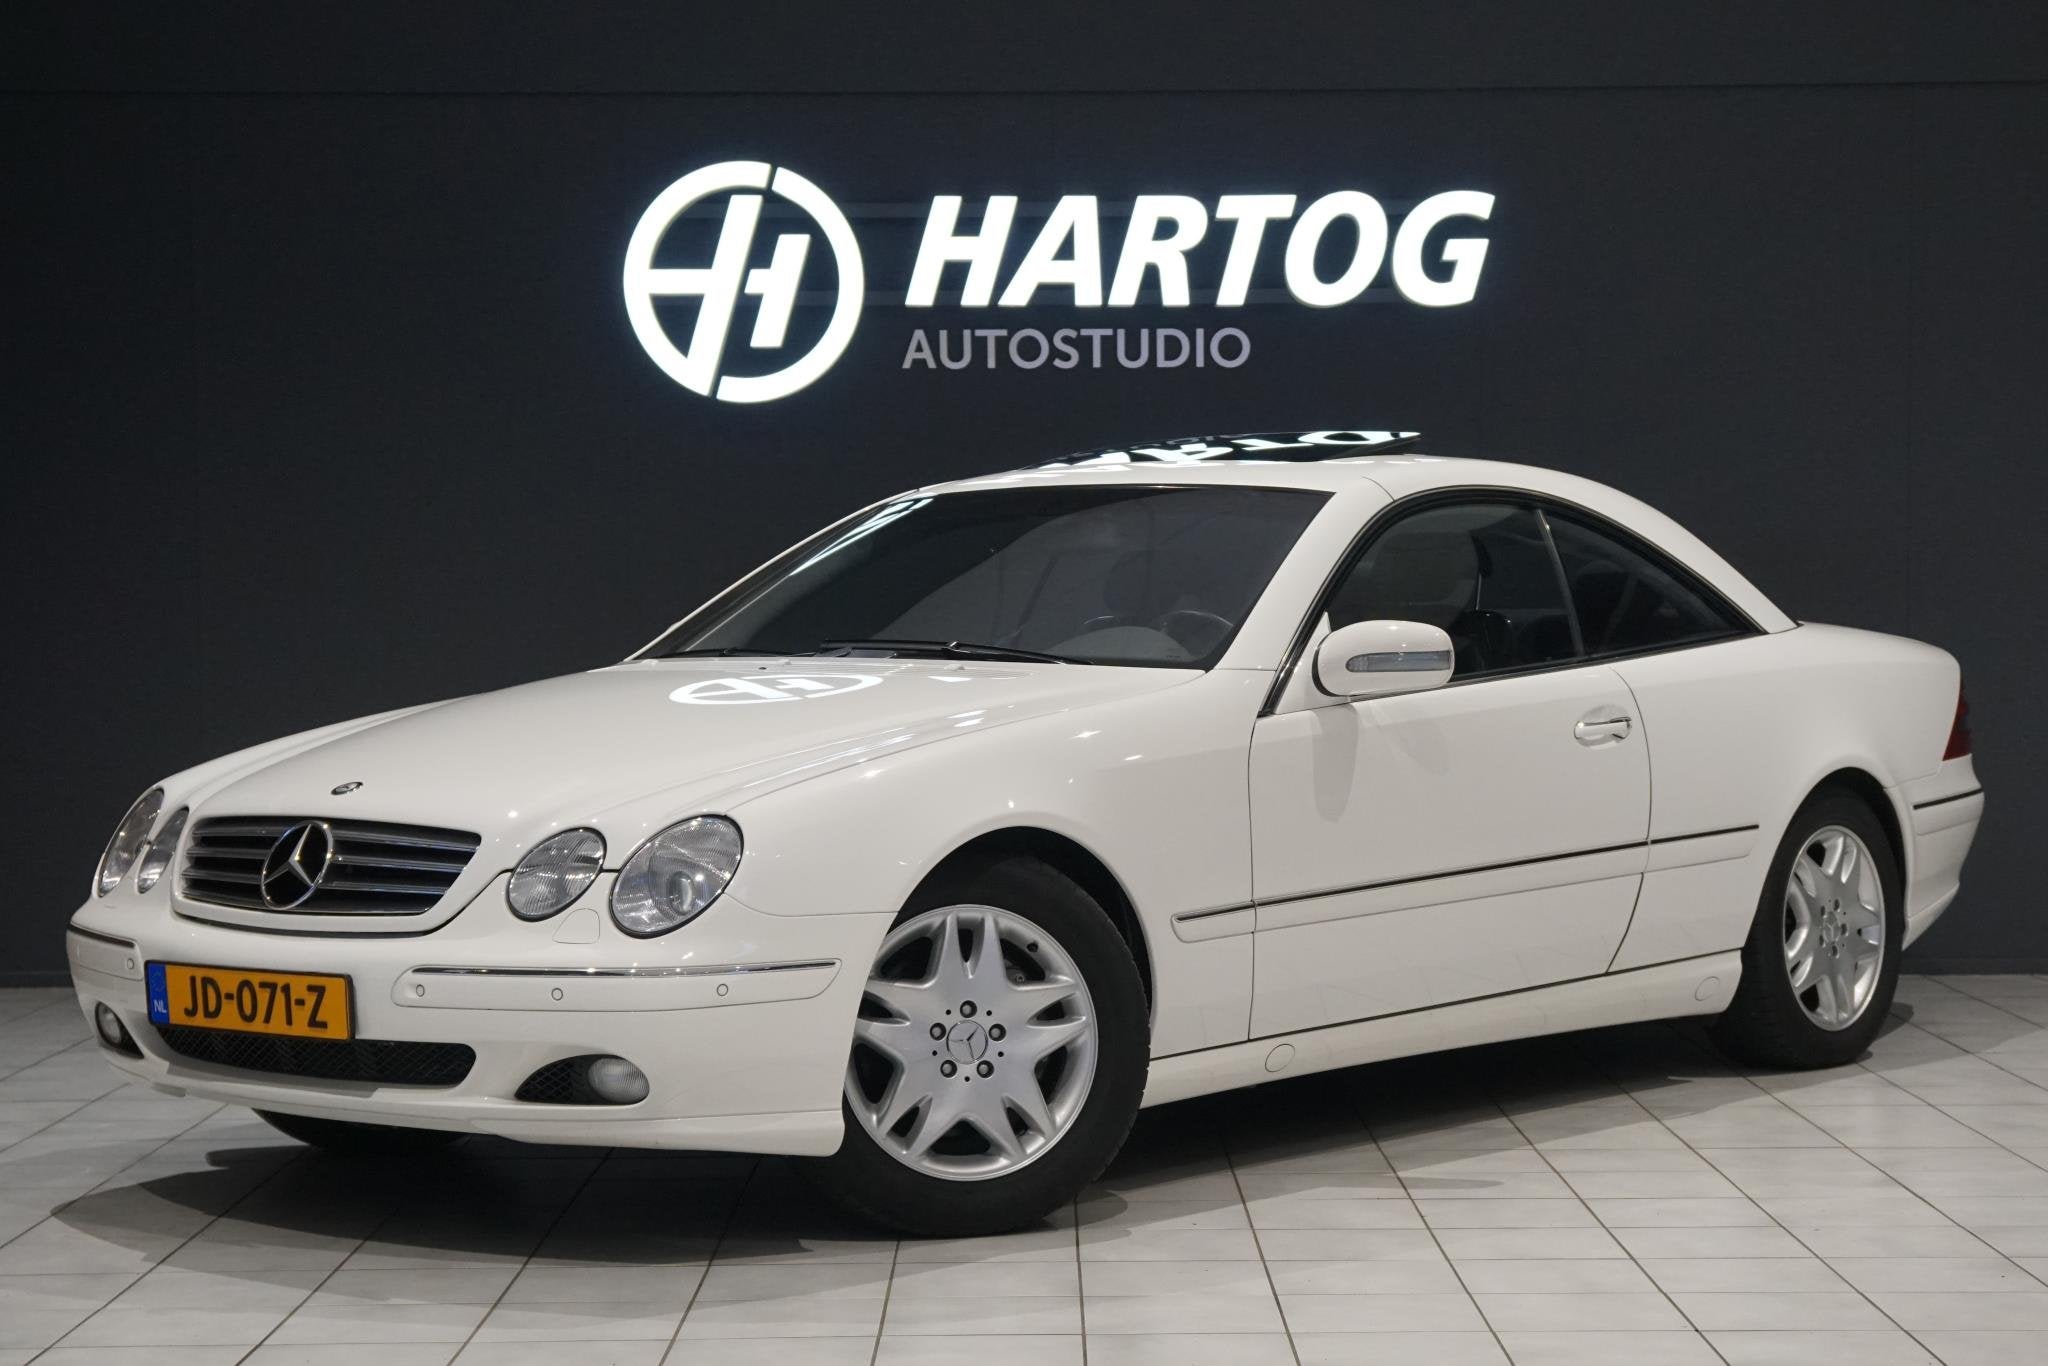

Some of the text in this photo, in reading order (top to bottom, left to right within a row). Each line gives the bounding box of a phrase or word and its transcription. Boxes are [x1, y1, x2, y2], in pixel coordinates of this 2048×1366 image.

[904, 190, 1496, 307] HARTOG
[902, 327, 1251, 370] AUTOSTUDIO
[154, 1000, 167, 1014] NL
[184, 975, 328, 1029] JD-071-Z
